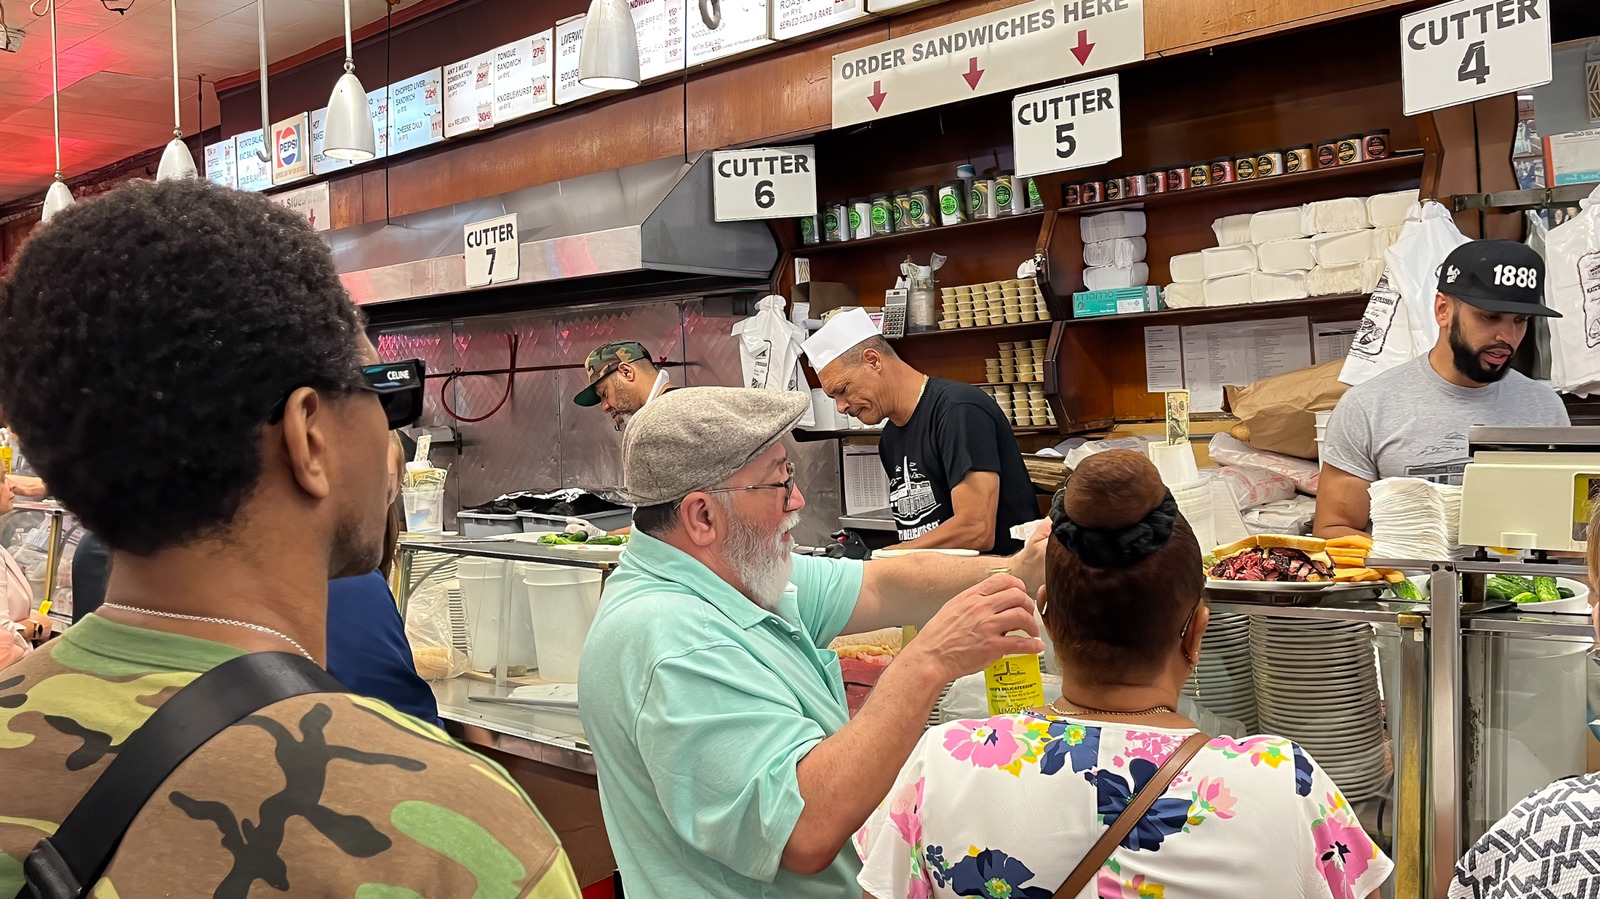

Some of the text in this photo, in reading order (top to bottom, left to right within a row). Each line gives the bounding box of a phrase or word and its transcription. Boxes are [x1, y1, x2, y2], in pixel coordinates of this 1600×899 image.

[780, 18, 798, 30] SERVED
[800, 13, 813, 24] COLD
[818, 6, 832, 18] RARE
[791, 6, 802, 16] RYE
[1408, 0, 1542, 50] CUTTER
[842, 0, 1129, 81] ORDER SANDWICHES HERE
[498, 48, 516, 60] TONGUE
[1458, 40, 1490, 85] 4
[459, 62, 469, 72] MEAT
[497, 58, 522, 72] SANDWICH
[448, 70, 472, 84] COMBINATION
[395, 84, 413, 96] CHOPPED
[448, 80, 466, 92] SANDWICH
[396, 93, 416, 106] SANDWICH
[497, 86, 532, 104] KNOBLEWURST
[1017, 87, 1114, 126] CUTTER
[397, 123, 412, 134] CHEESE
[280, 138, 297, 154] PEPSI
[1056, 122, 1076, 158] 5
[718, 154, 810, 178] CUTTER
[755, 180, 775, 208] 6
[467, 223, 514, 248] CUTTER
[486, 247, 496, 276] 7
[1494, 264, 1537, 288] 1888
[1077, 291, 1114, 300] momo
[387, 370, 410, 380] CELINE
